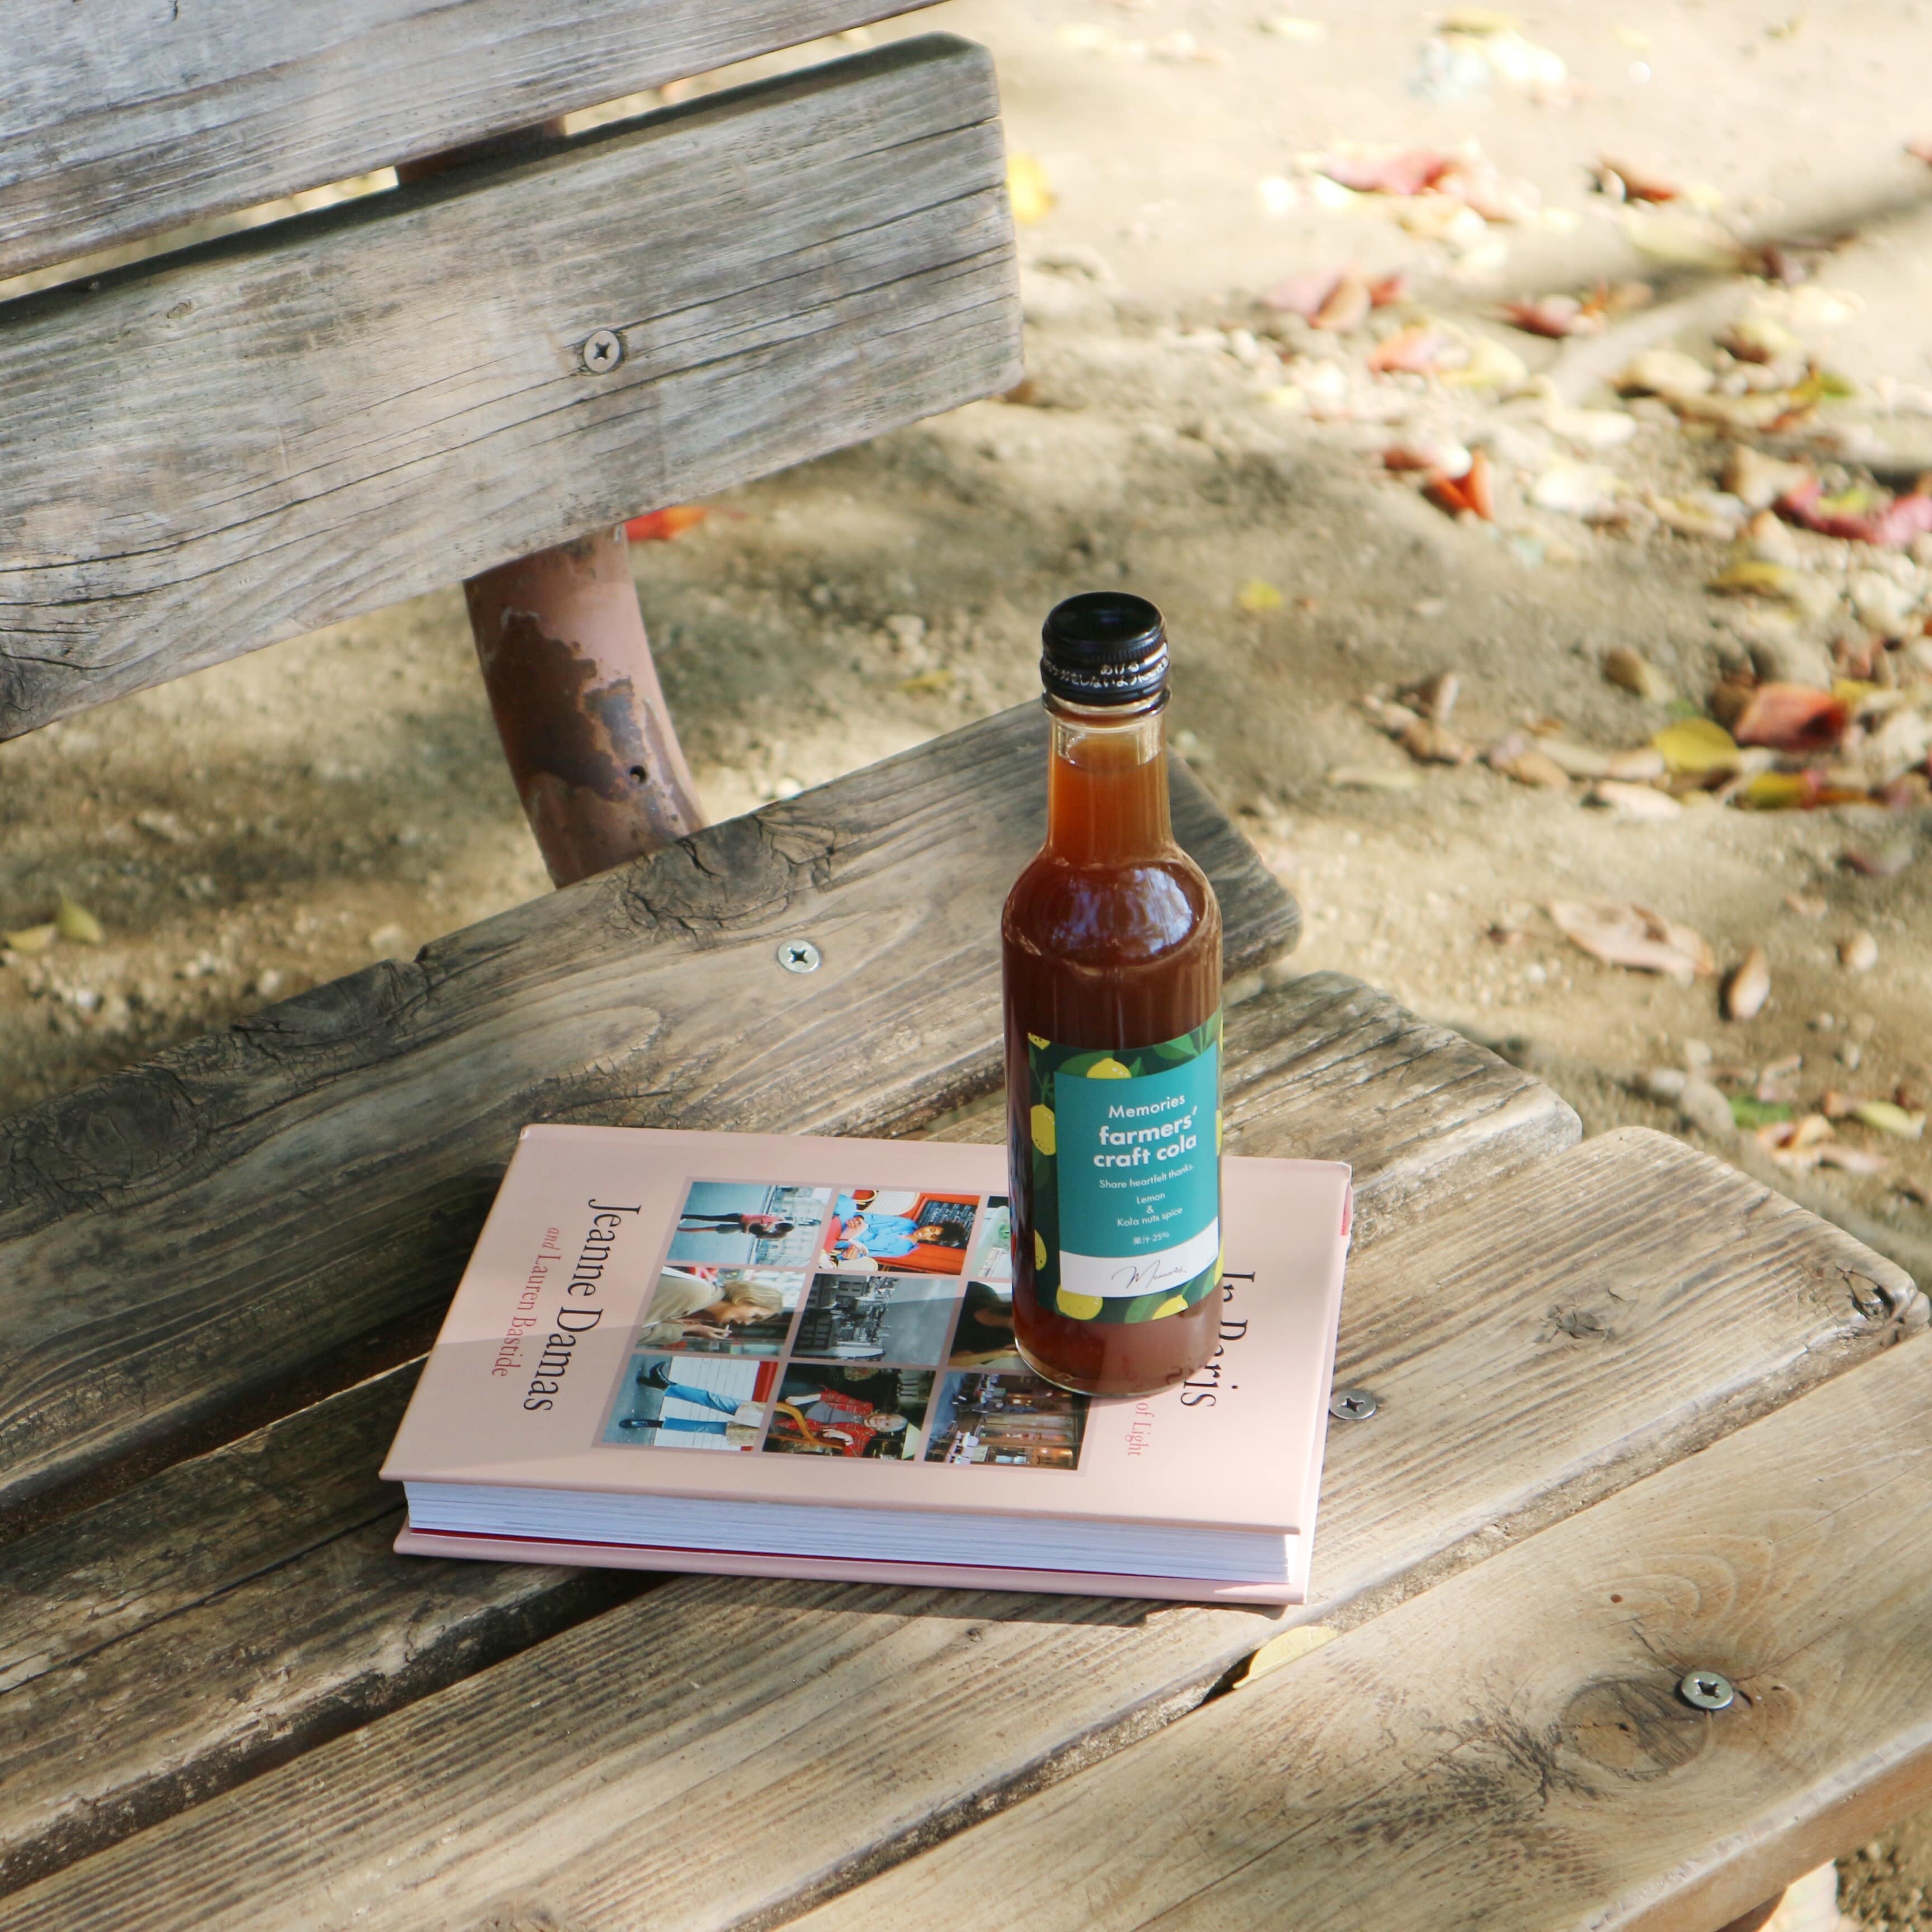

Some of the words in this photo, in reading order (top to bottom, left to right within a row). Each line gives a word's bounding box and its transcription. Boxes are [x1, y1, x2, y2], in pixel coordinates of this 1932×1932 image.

[1109, 1095, 1186, 1118] Memories
[1093, 1147, 1151, 1167] craft
[1156, 1134, 1197, 1161] cola
[1100, 1180, 1127, 1188] Share
[1129, 1172, 1167, 1187] heartfelt
[1169, 1163, 1195, 1179] thanks.
[1137, 1192, 1166, 1205] Lemon
[1146, 1205, 1154, 1214] &
[1117, 1218, 1139, 1227] Kola
[1142, 1214, 1160, 1224] nuts
[1162, 1207, 1183, 1221] spice
[542, 1227, 560, 1251] and
[567, 1198, 642, 1297] Jeanne
[517, 1254, 561, 1311] Lauren
[492, 1316, 537, 1377] Bastide
[523, 1306, 604, 1411] Damas
[1135, 1402, 1155, 1418] of
[1125, 1422, 1152, 1456] Light
